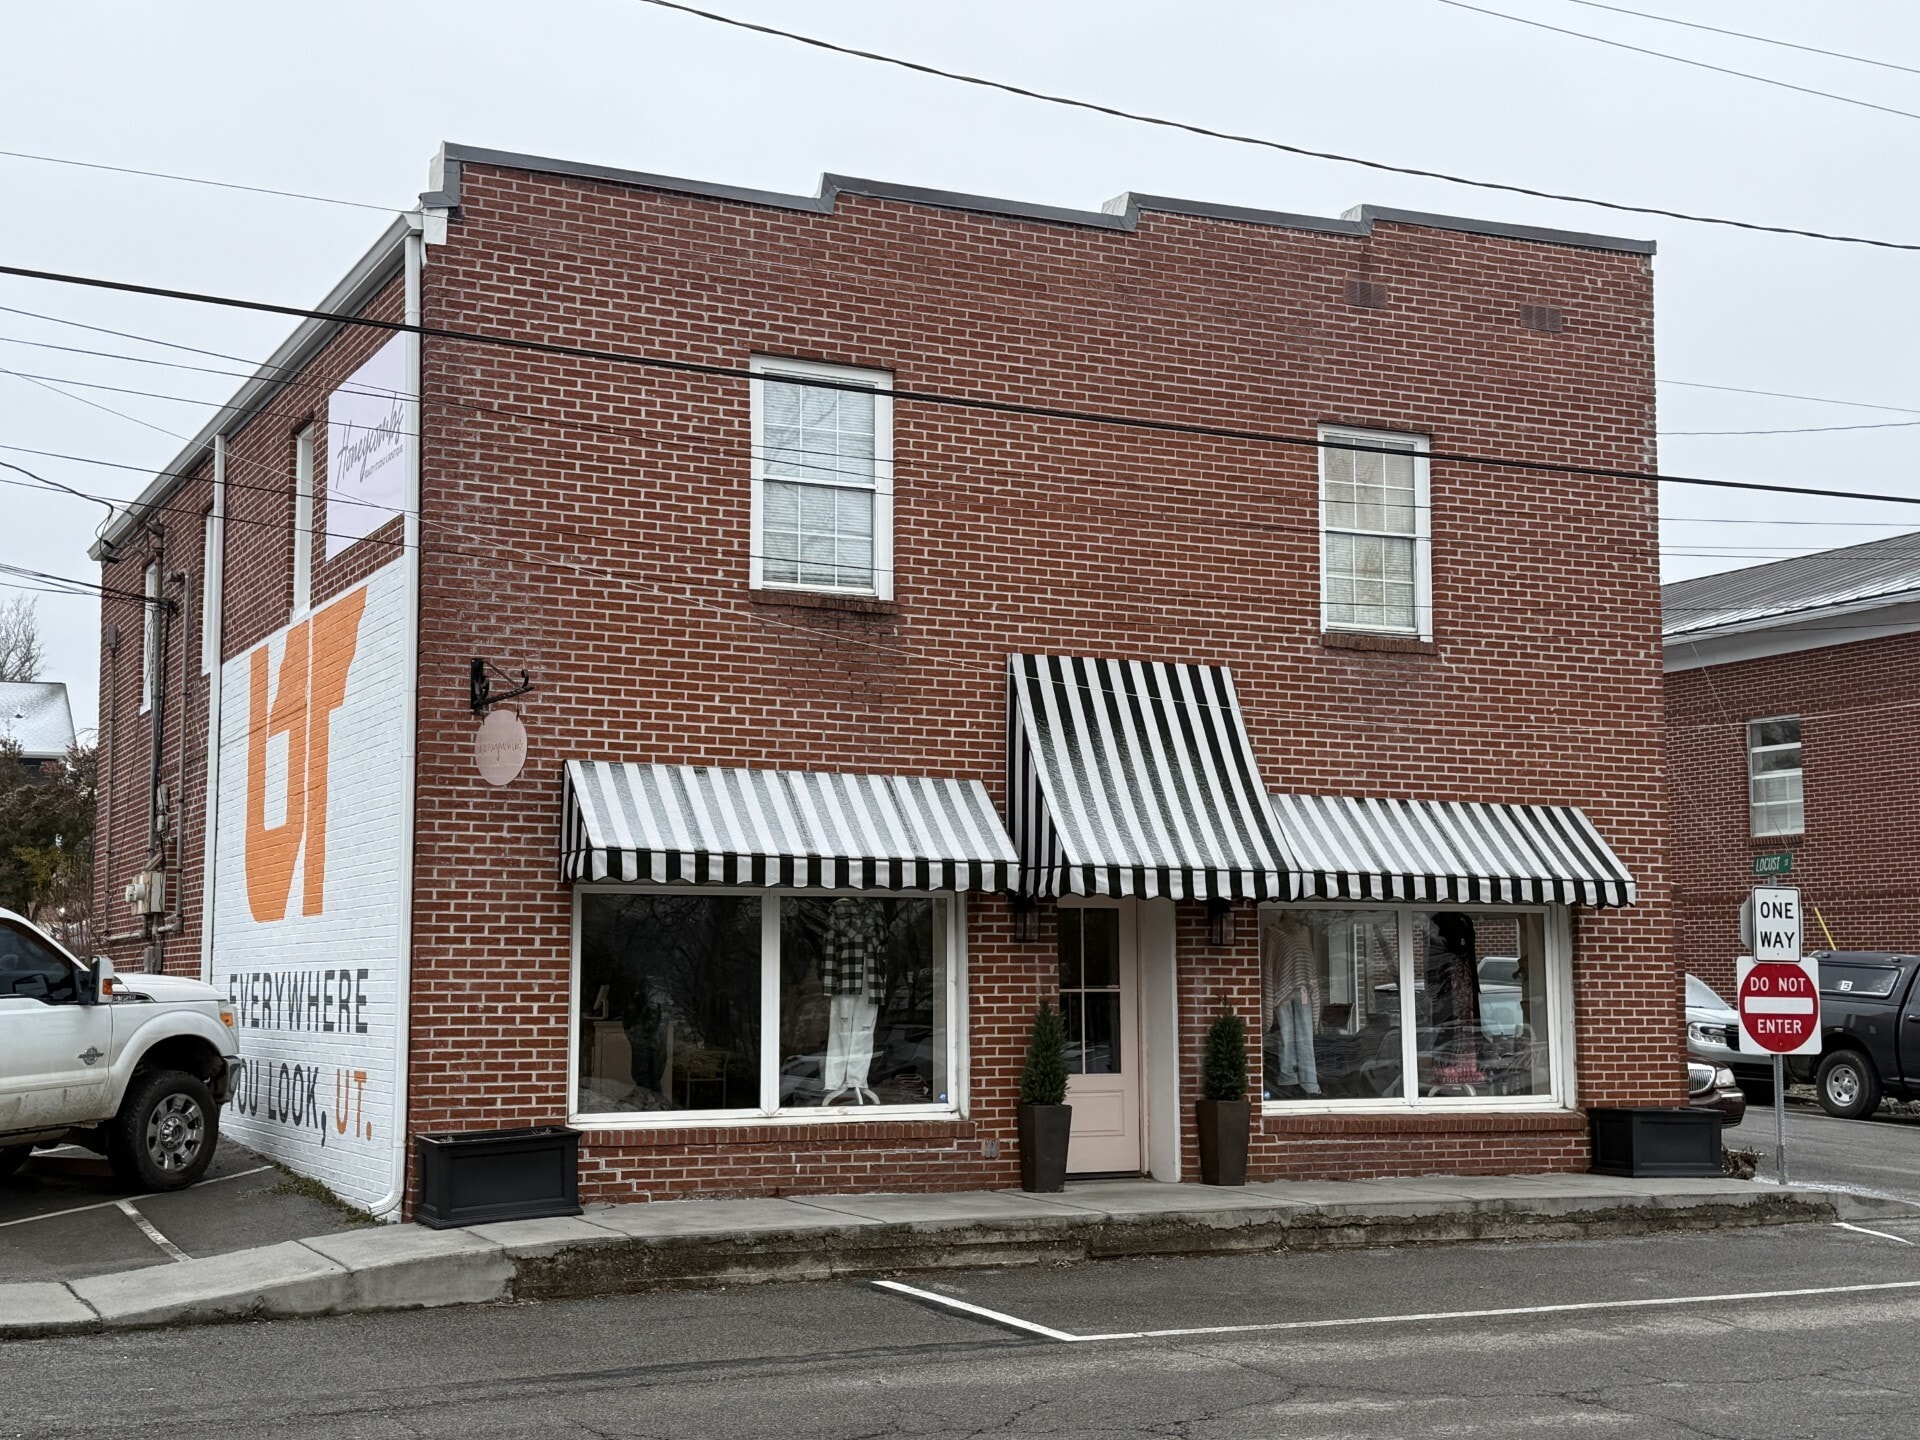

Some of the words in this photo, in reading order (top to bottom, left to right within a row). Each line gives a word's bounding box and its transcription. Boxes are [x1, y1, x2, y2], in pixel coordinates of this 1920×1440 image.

[1755, 856, 1781, 872] LOCUST
[1760, 901, 1794, 919] ONE
[1760, 931, 1795, 948] WAY
[1750, 976, 1769, 992] DO
[1778, 977, 1806, 992] NOT
[229, 968, 369, 1034] EVERYWHERE
[1757, 1019, 1802, 1034] ENTER
[230, 1057, 259, 1117] OU
[268, 1061, 327, 1147] LOOK,
[335, 1068, 372, 1142] UT.
